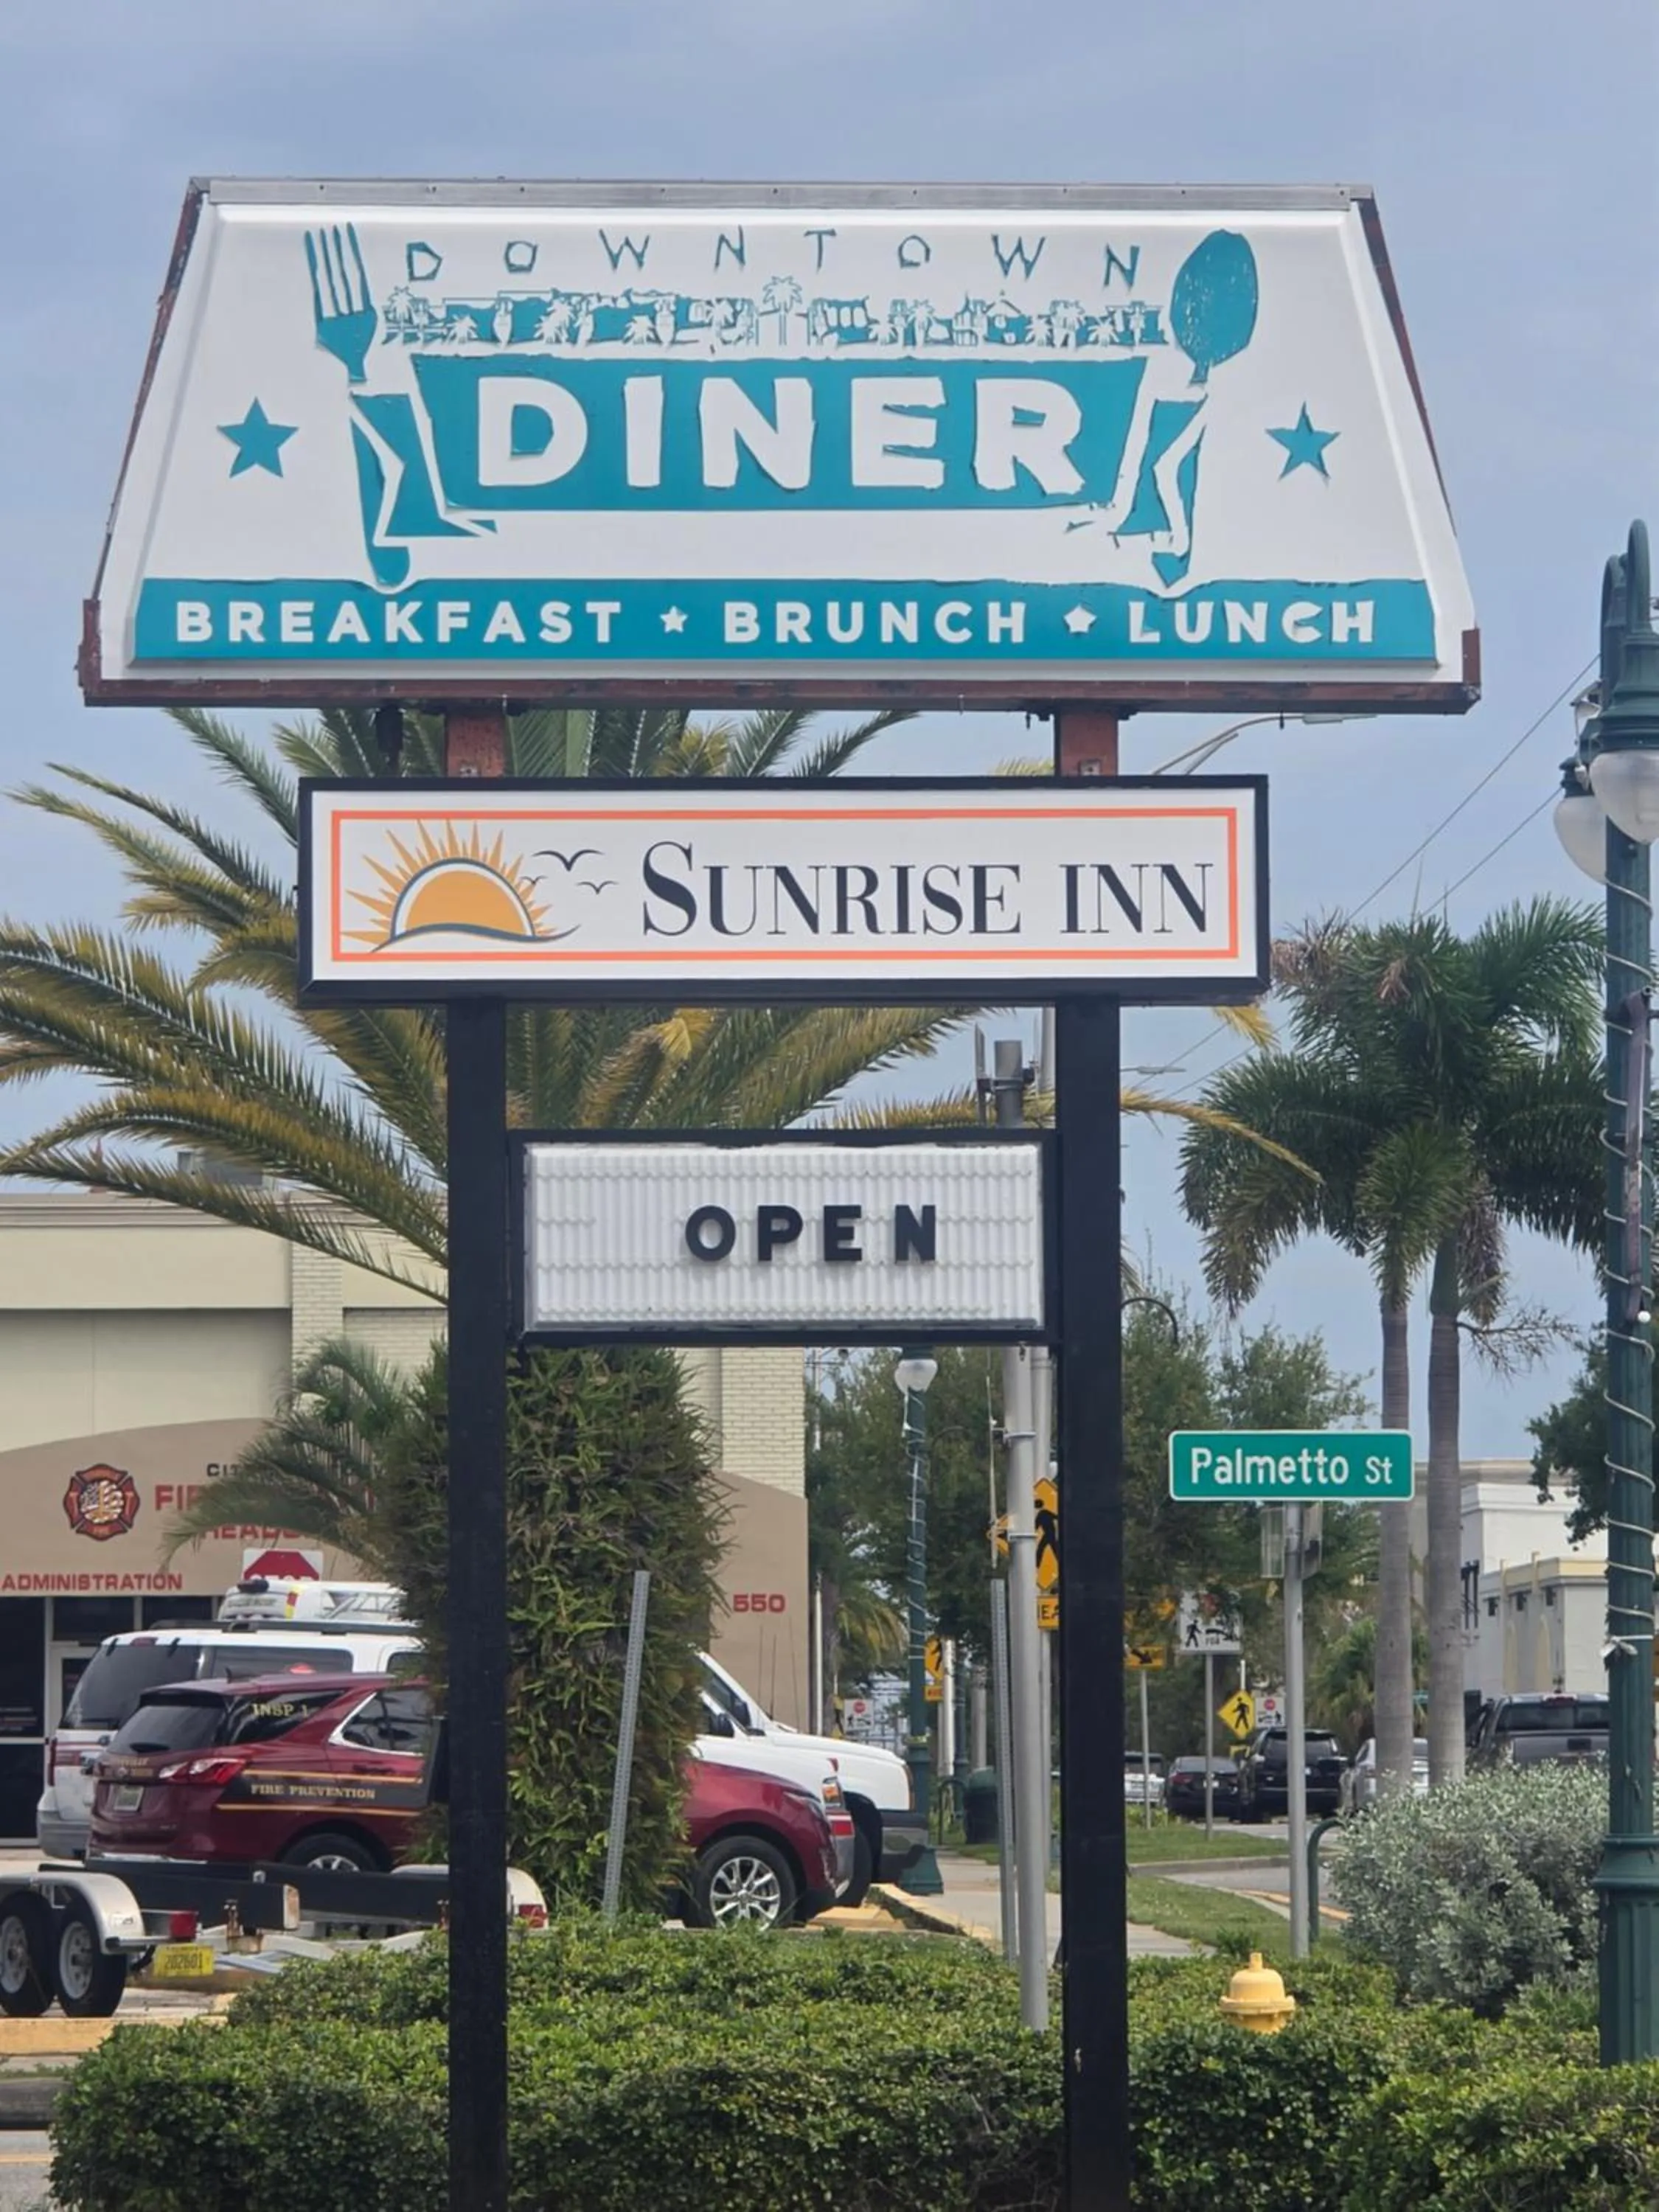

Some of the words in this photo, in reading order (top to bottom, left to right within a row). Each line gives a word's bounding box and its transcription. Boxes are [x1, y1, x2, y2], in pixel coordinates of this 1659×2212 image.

[406, 224, 1139, 290] DOWNTOWN
[478, 375, 1086, 496] DINER
[175, 601, 622, 644] BREAKFAST
[723, 601, 1026, 644] BRUNCH
[1129, 599, 1375, 644] LUNCH
[642, 841, 1022, 936] SUNRISE
[1060, 863, 1214, 934] INN
[684, 1204, 936, 1262] OPEN
[1191, 1447, 1349, 1485] Palmetto
[1365, 1455, 1393, 1485] St
[1, 1573, 183, 1590] ADMINISTRATION
[733, 1593, 786, 1613] 550
[253, 1703, 294, 1717] INSP
[251, 1784, 284, 1795] FIRE
[290, 1785, 376, 1799] PREVENTION
